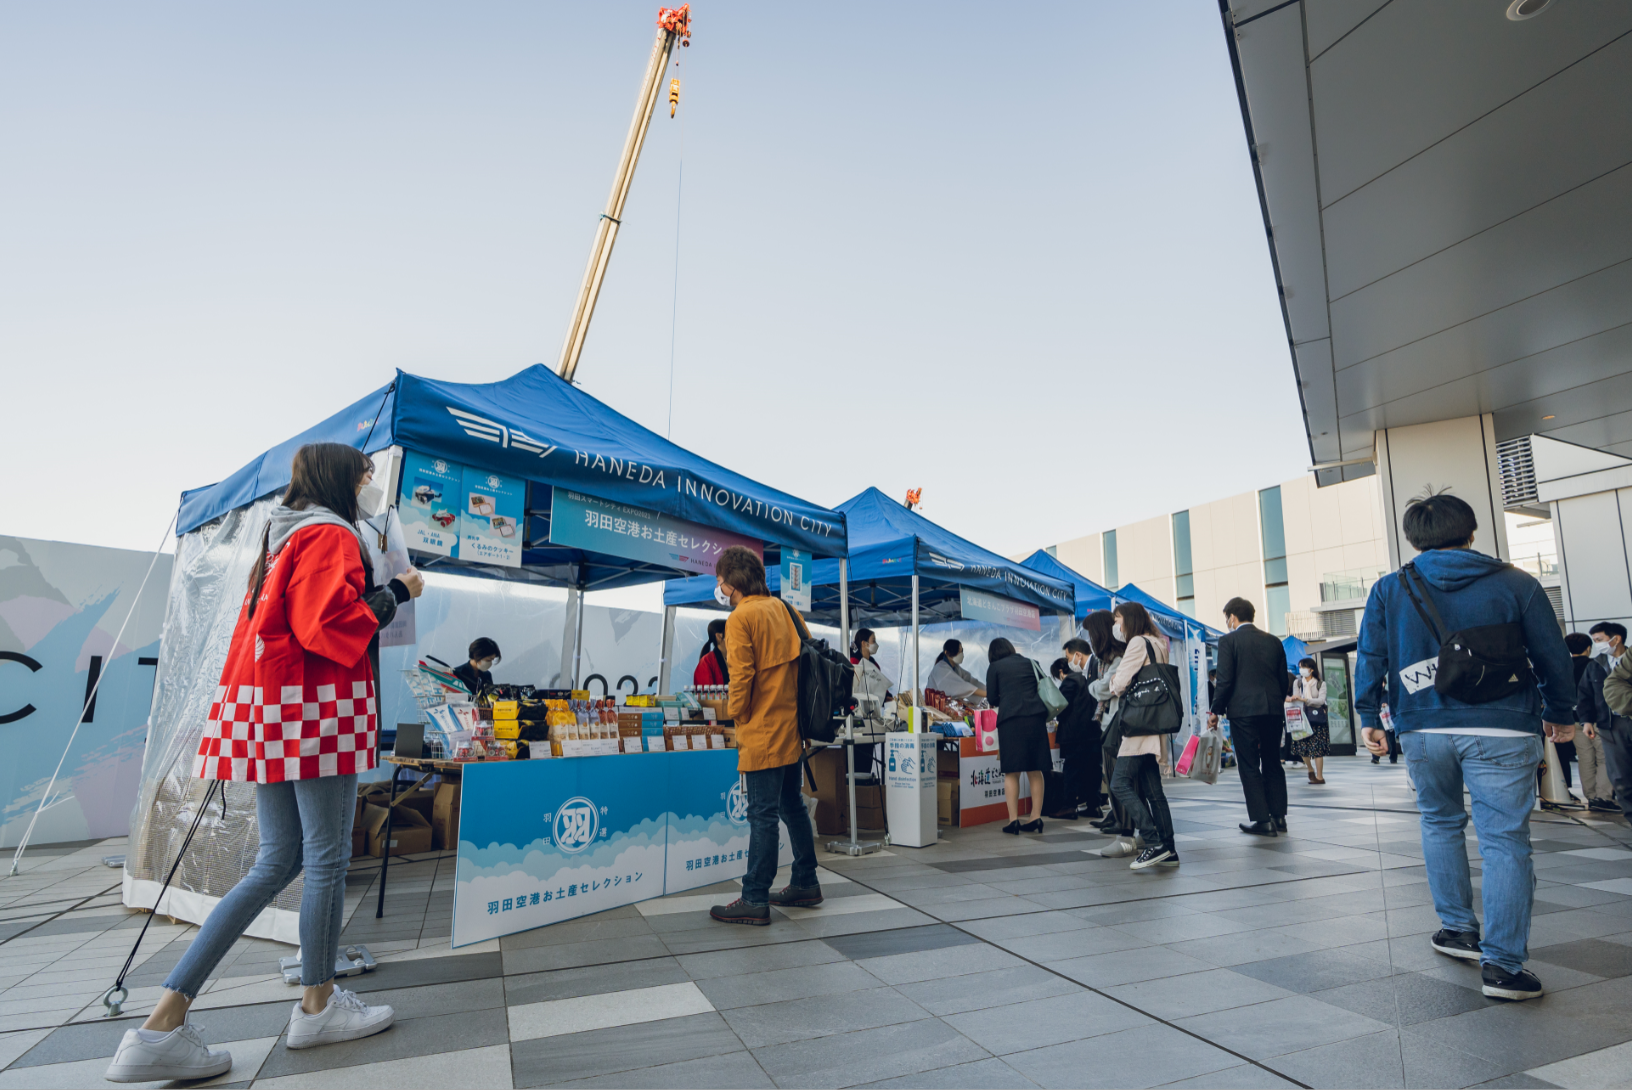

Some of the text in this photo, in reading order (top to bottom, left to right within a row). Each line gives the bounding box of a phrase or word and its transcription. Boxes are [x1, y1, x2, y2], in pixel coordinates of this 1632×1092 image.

[574, 449, 832, 537] HANEDA INNOVATION CITY
[471, 542, 514, 554] くるみのクッキー
[584, 509, 723, 555] 羽田空港お土産セレクシ
[970, 564, 1068, 601] HANEDA INNOVATION CITY
[487, 871, 643, 915] 羽田空港お土産セレクション
